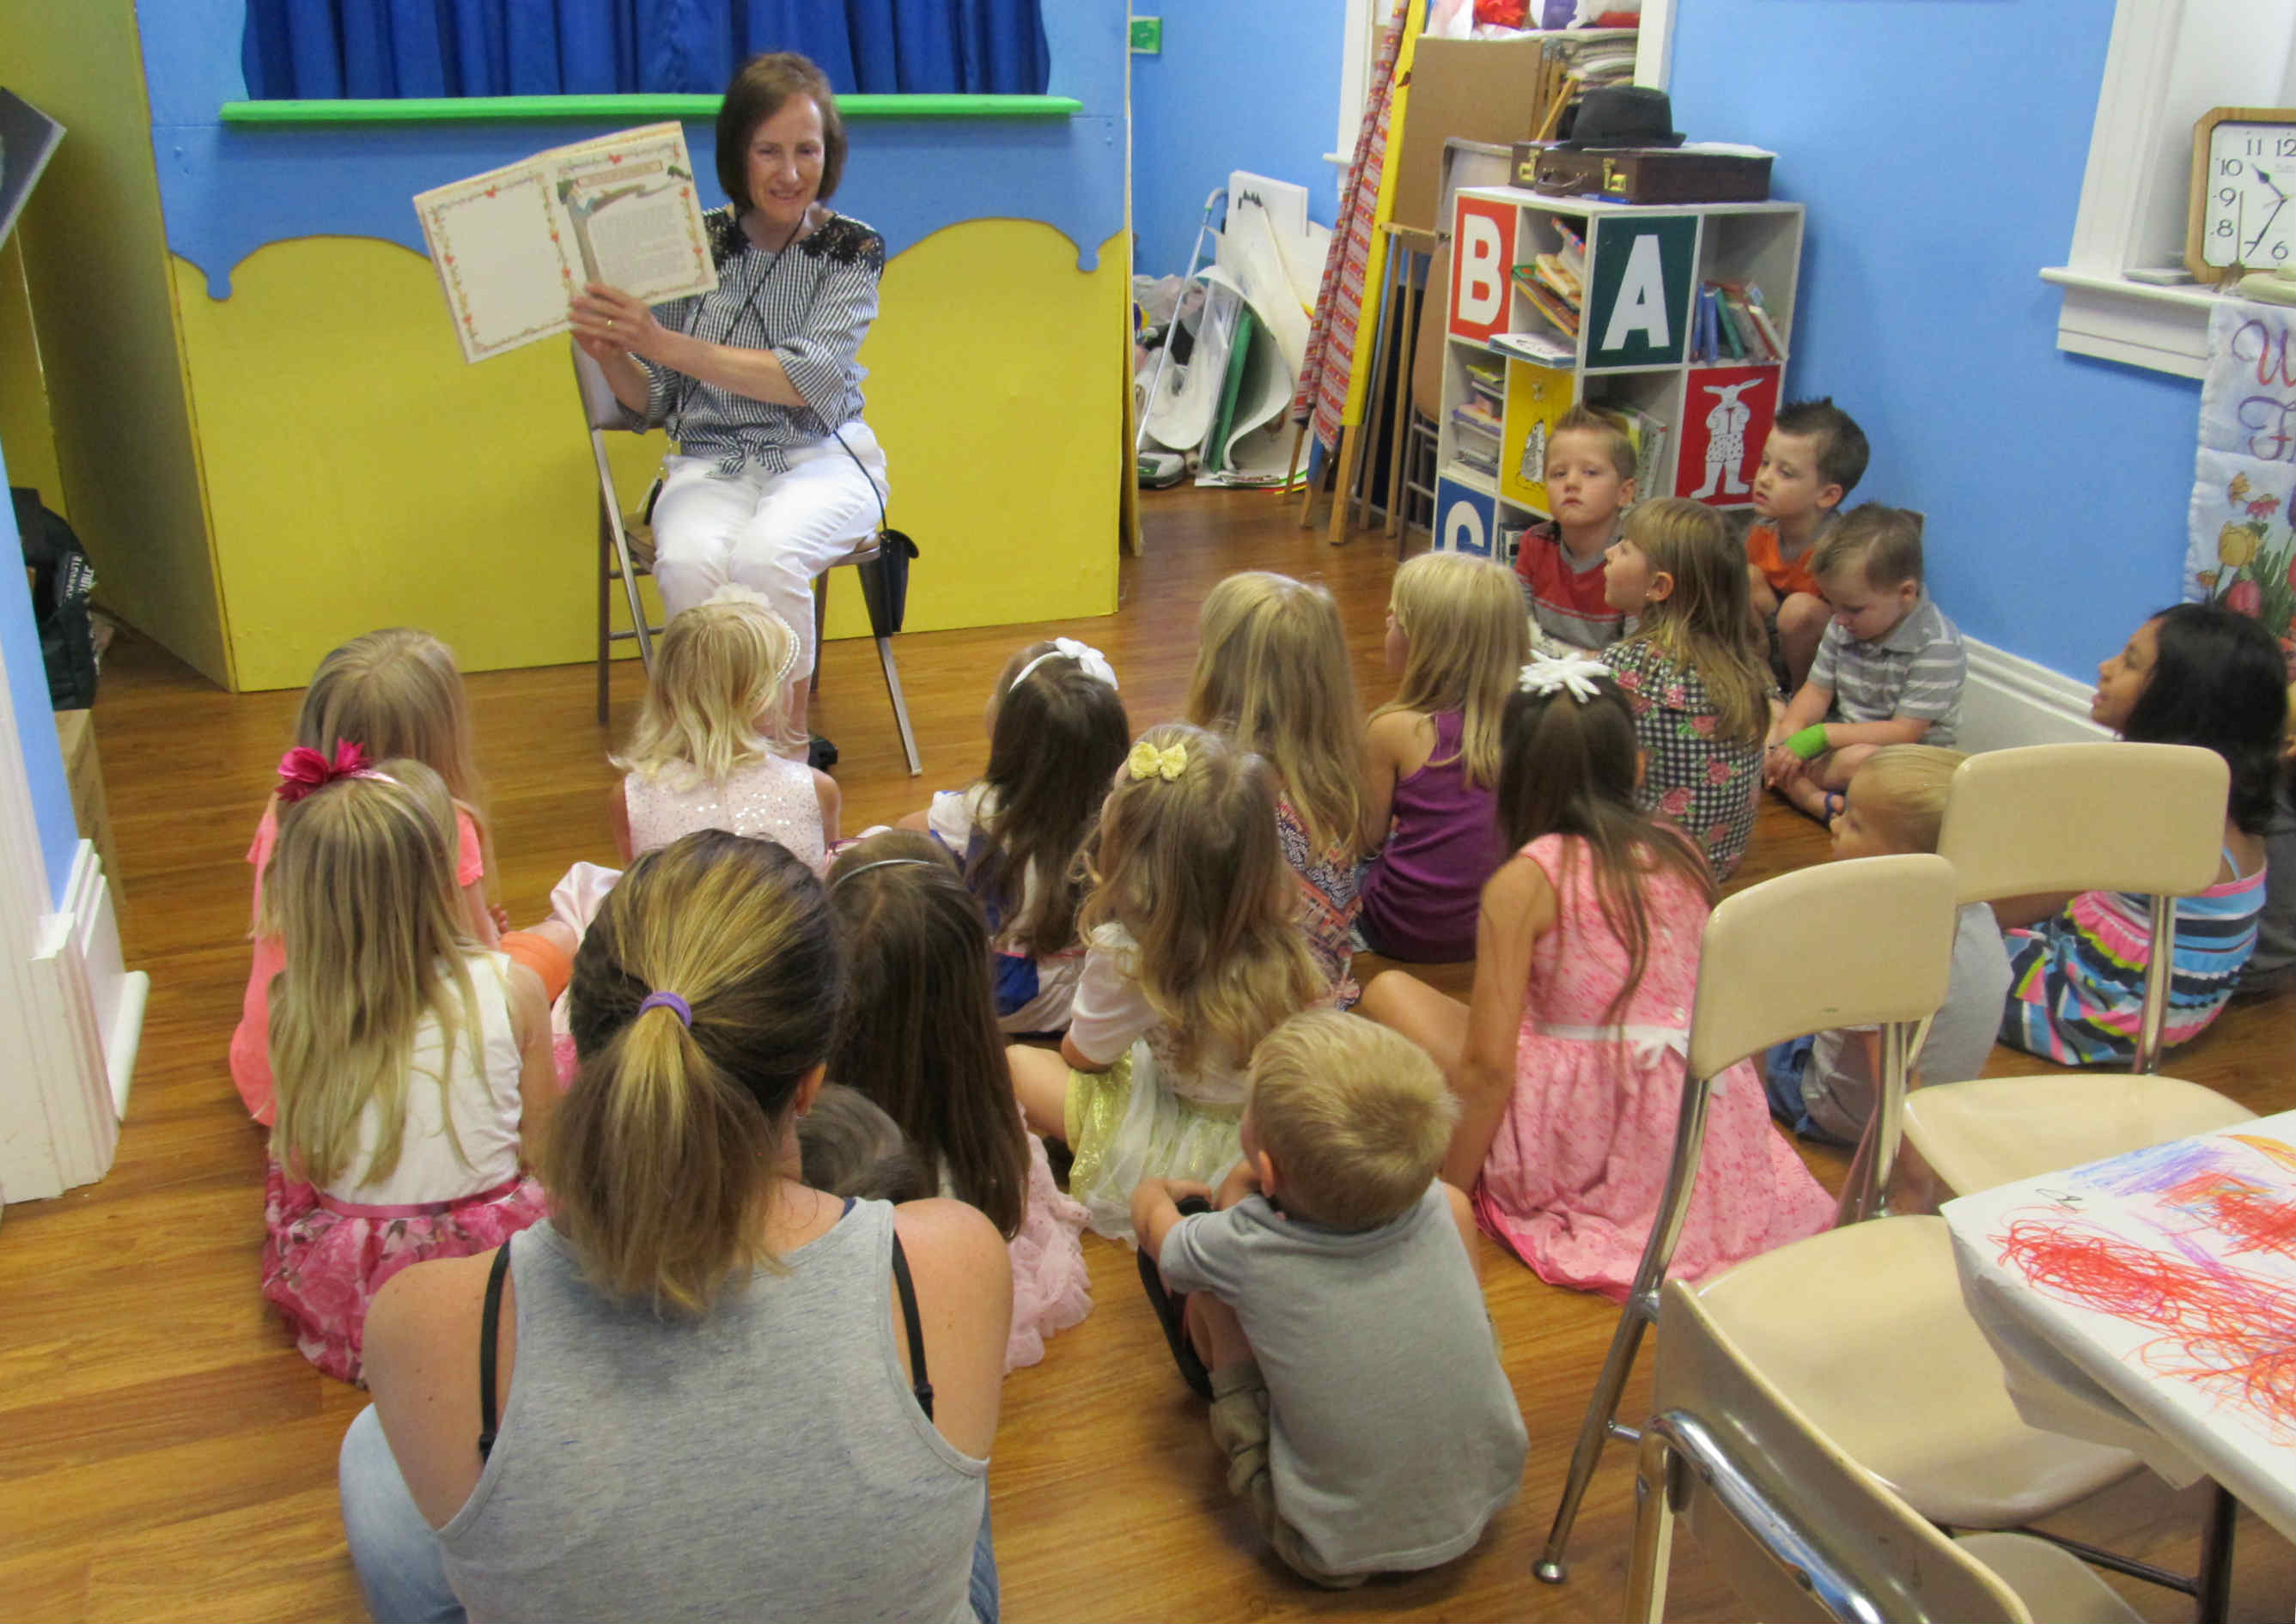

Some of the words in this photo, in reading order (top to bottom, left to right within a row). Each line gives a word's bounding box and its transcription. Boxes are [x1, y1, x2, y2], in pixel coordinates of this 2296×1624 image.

[2246, 138, 2263, 156] 11
[2220, 158, 2244, 177] 10
[2219, 187, 2237, 207] 9
[2216, 218, 2234, 238] 8
[2270, 240, 2289, 260] 6
[1458, 213, 1503, 326] B
[1600, 234, 1671, 351] A
